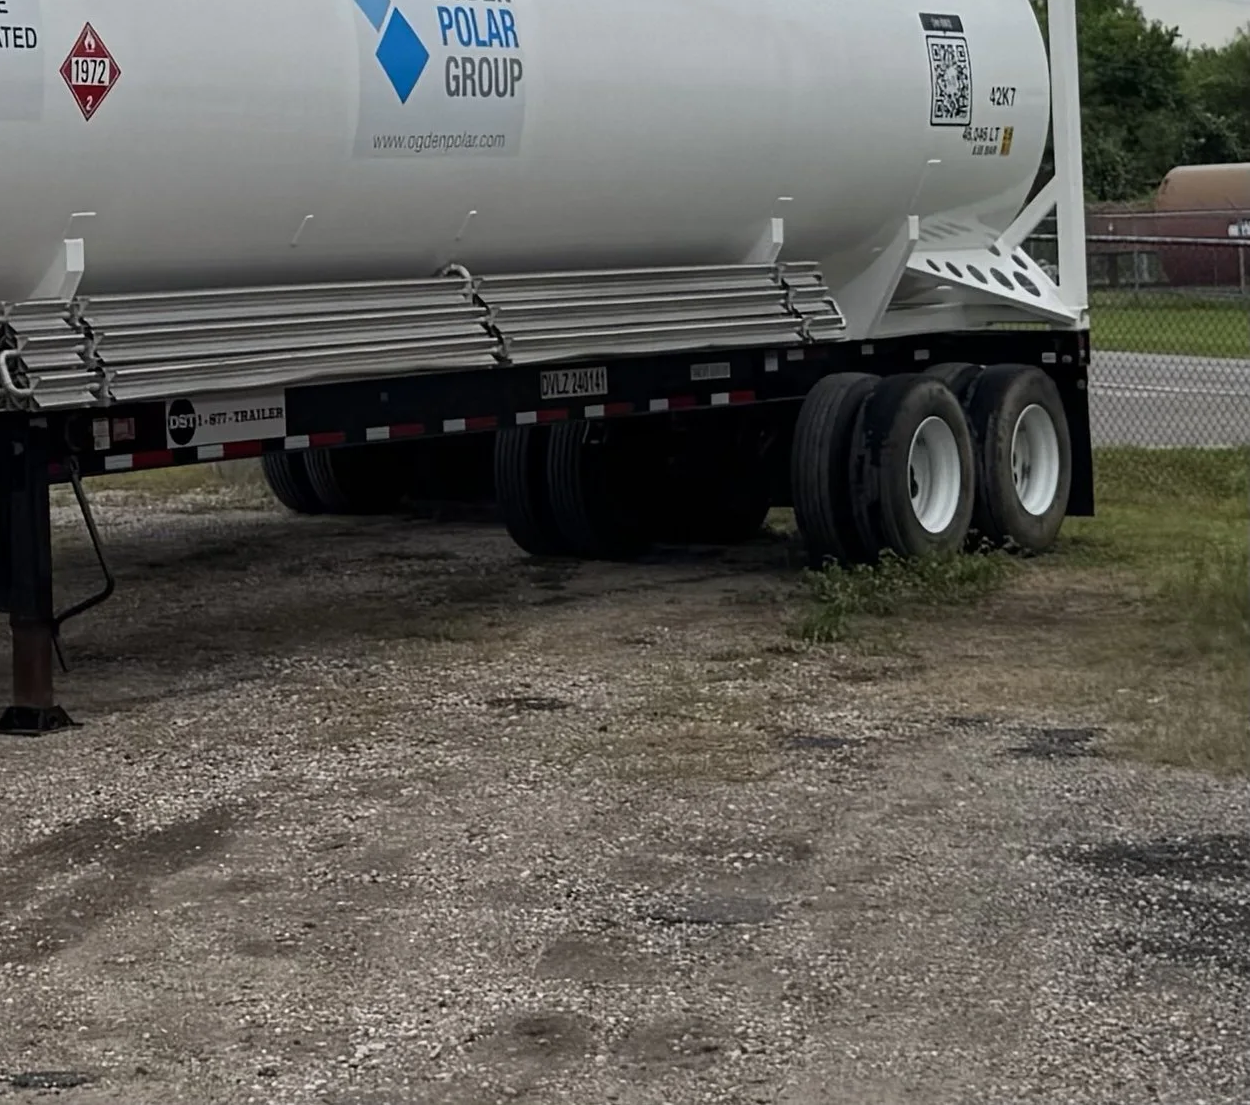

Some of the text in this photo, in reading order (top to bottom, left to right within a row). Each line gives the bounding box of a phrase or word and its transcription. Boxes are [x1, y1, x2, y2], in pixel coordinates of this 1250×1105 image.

[437, 6, 520, 48] POLAR
[73, 59, 107, 84] 1972
[445, 56, 523, 98] GROUP
[85, 94, 93, 111] 2
[989, 86, 1016, 106] 42K7
[373, 130, 506, 153] www.ogdenpolar.com
[542, 372, 569, 396] DVLZ
[169, 414, 197, 429] DST
